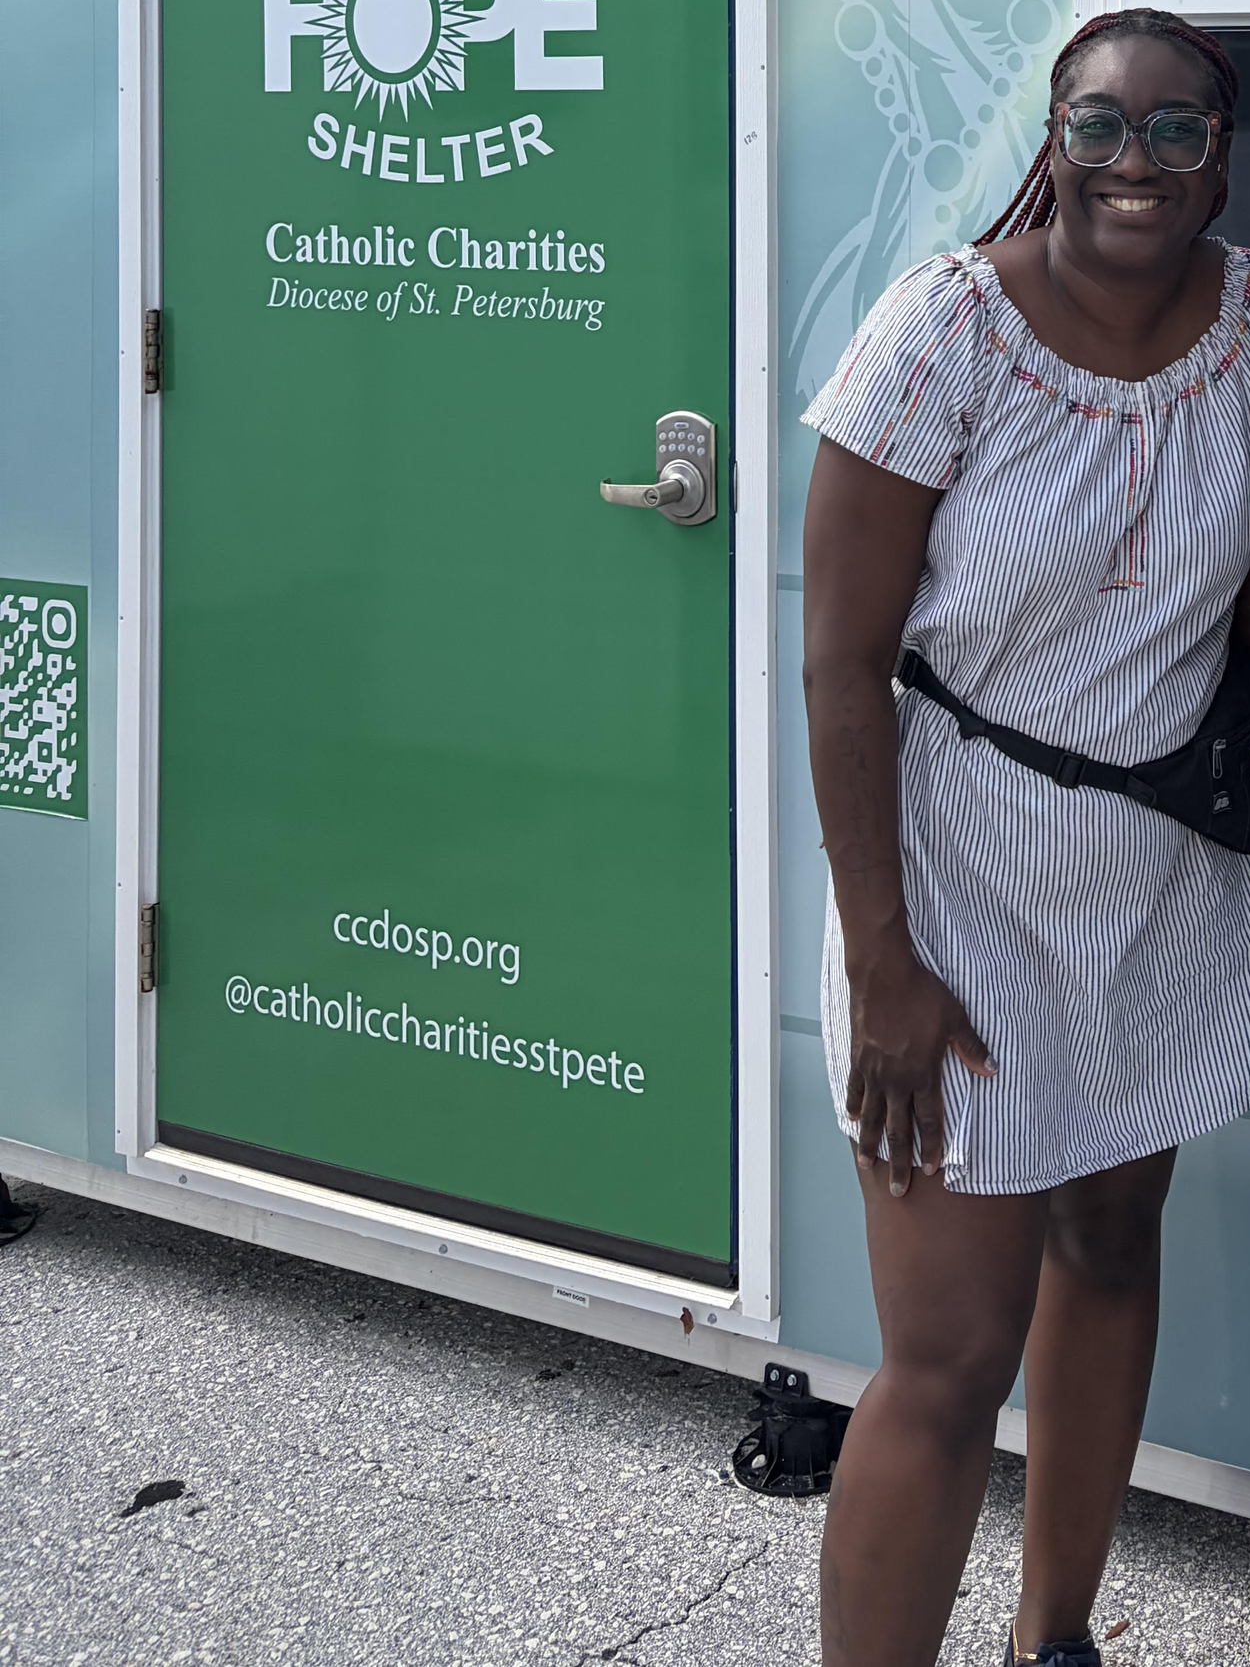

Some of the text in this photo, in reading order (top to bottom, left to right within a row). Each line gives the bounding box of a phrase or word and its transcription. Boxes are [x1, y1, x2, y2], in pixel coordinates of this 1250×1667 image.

[307, 112, 555, 184] SHELTER
[265, 222, 606, 274] Catholic Charities
[266, 277, 606, 331] Diocese of St. Petersburg
[333, 908, 520, 985] ccdosp.org
[225, 975, 645, 1094] @catholiccharitiesstpete
